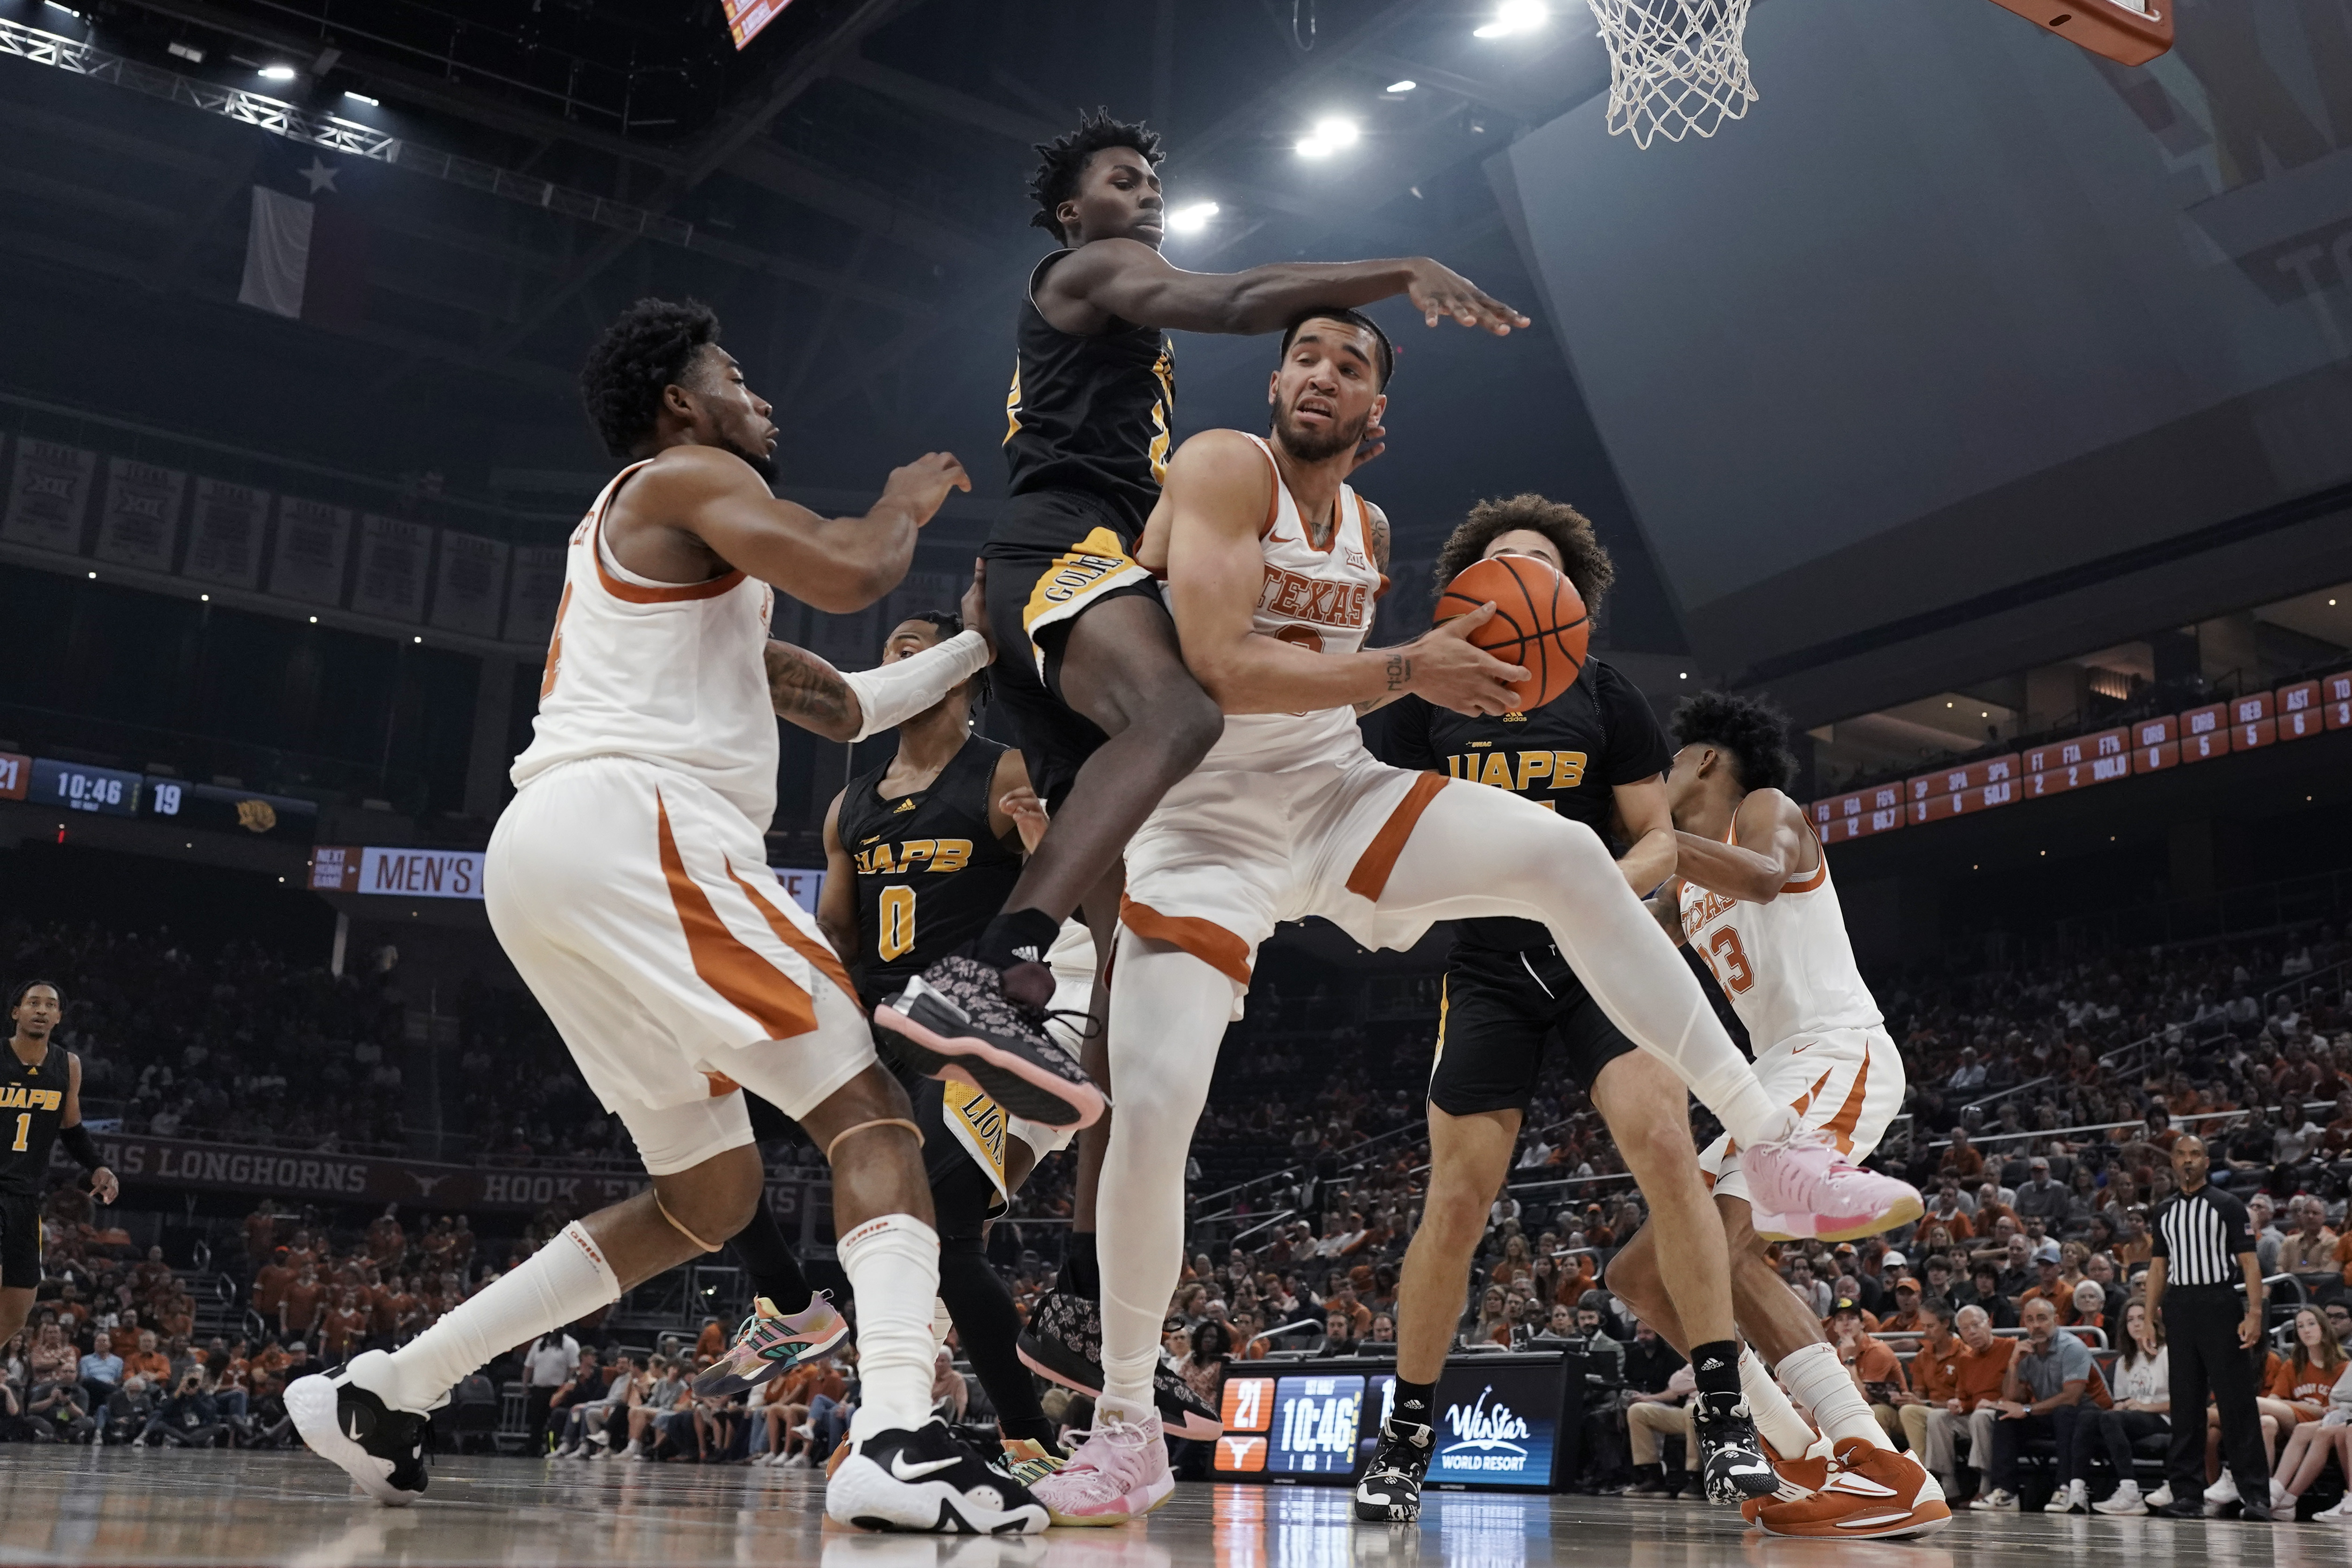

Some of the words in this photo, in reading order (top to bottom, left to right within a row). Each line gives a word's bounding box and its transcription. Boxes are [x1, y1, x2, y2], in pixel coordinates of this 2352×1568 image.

[2287, 688, 2310, 713] AST
[2332, 678, 2352, 699] TO
[2034, 774, 2044, 793] 2
[2069, 767, 2077, 787] 2
[2199, 736, 2210, 756] 5
[2246, 724, 2257, 745] 5
[2338, 703, 2351, 724] 3
[1447, 750, 1588, 790] UAPB
[58, 772, 123, 805] 10:46
[154, 783, 182, 816] 19
[375, 854, 473, 894] MEN'S
[878, 885, 917, 962] 0
[0, 1087, 62, 1111] UAPB
[12, 1112, 32, 1152] 1
[156, 1148, 367, 1194] LONGHORNS
[483, 1174, 582, 1205] HOOK
[1701, 1361, 1725, 1371] adidas
[1233, 1380, 1262, 1429] 21
[1281, 1397, 1355, 1453] 10:46
[1380, 1379, 1396, 1429] 1
[1444, 1384, 1531, 1441] WinStar
[1441, 1455, 1482, 1470] WORLD
[1482, 1456, 1527, 1471] RESORT
